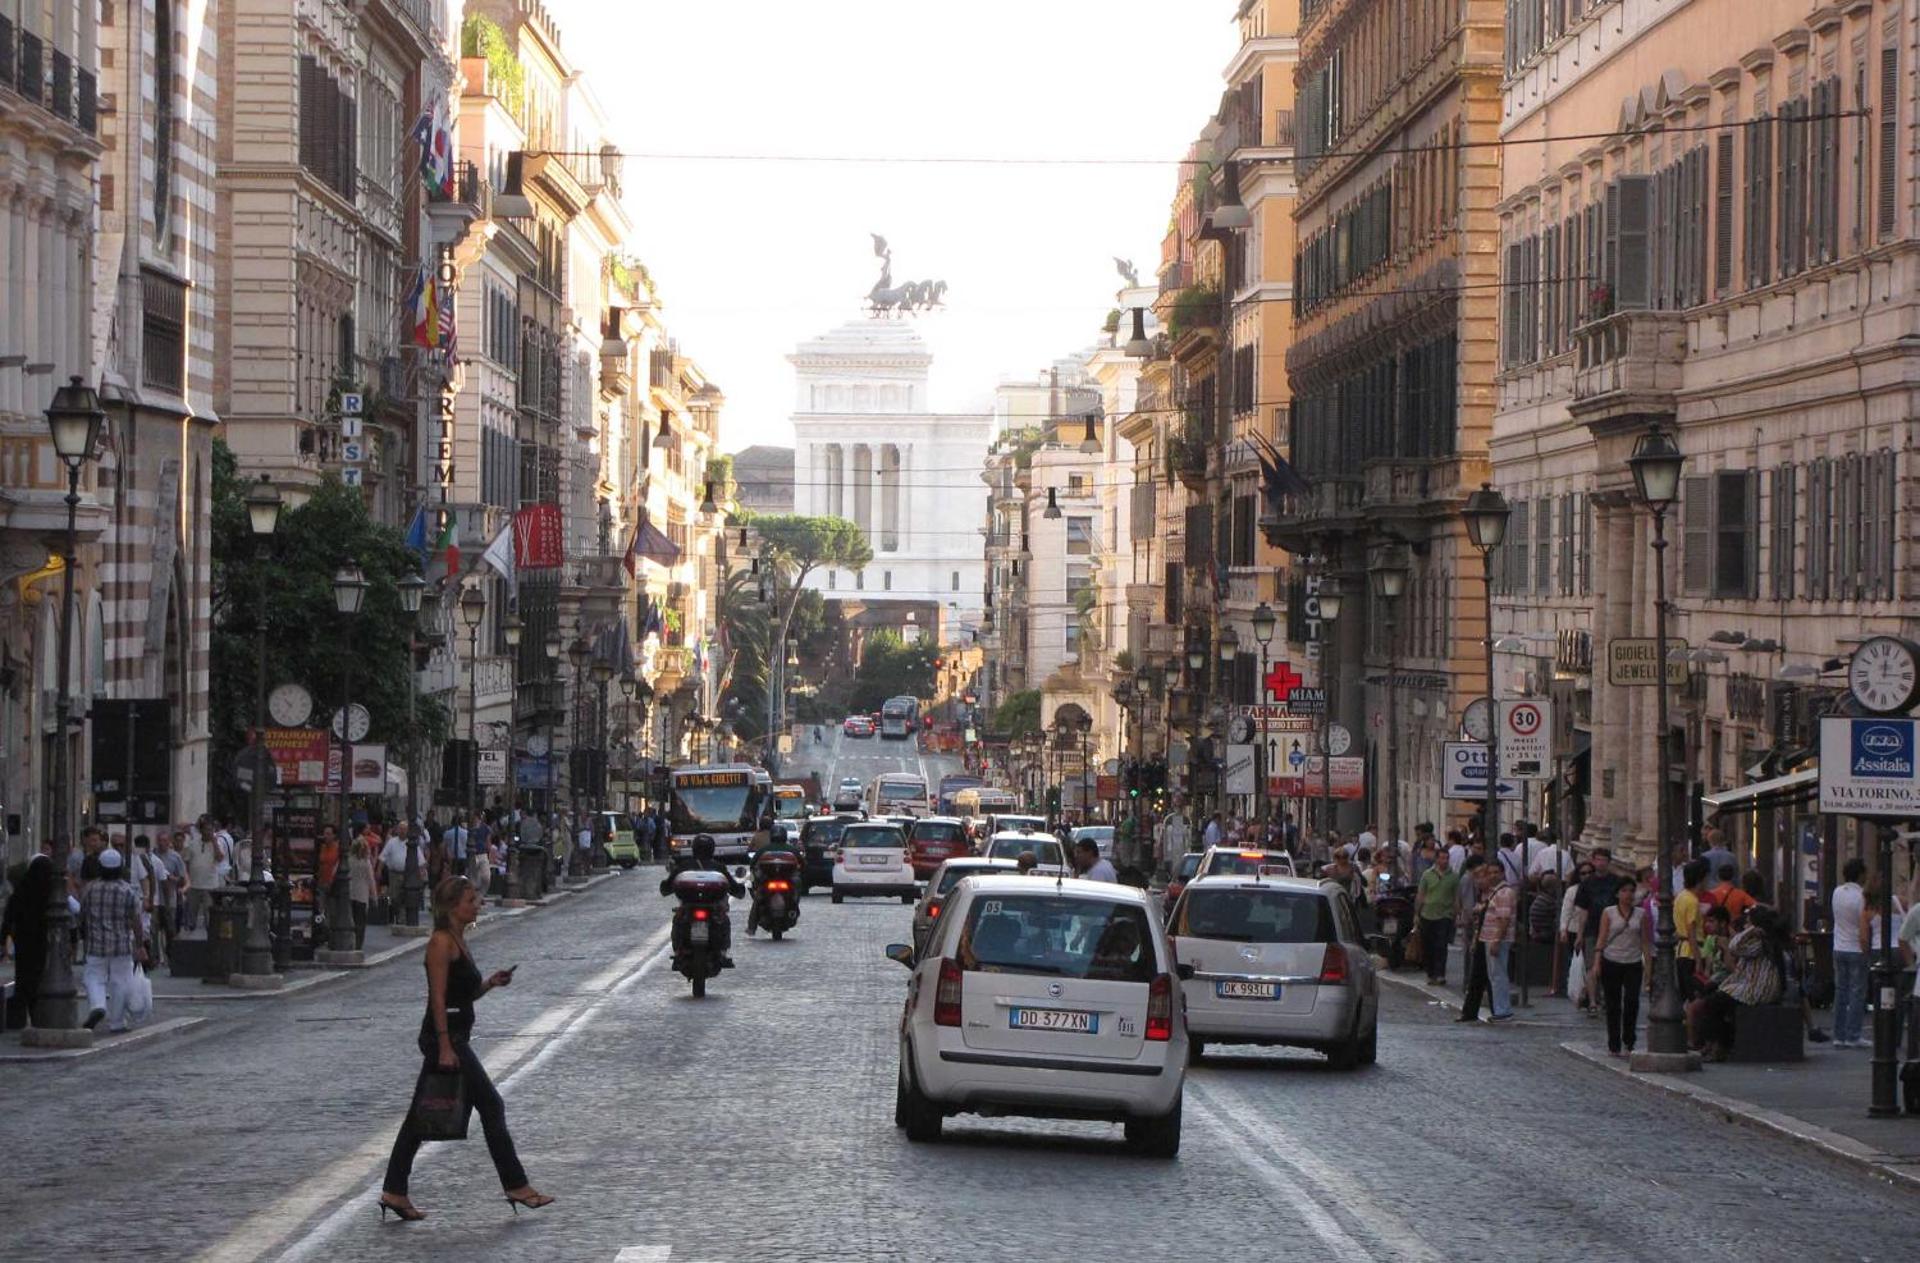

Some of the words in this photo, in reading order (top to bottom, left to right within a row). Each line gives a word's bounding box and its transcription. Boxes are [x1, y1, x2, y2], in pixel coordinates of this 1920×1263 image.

[1616, 664, 1681, 679] JEWELLRY
[1516, 712, 1535, 726] 30
[1854, 756, 1911, 773] Assitalia
[1831, 786, 1854, 798] VIA
[1857, 787, 1913, 801] TORINO,
[986, 902, 1001, 912] 05
[1020, 1011, 1038, 1025] DD
[1043, 1012, 1089, 1029] 377XN
